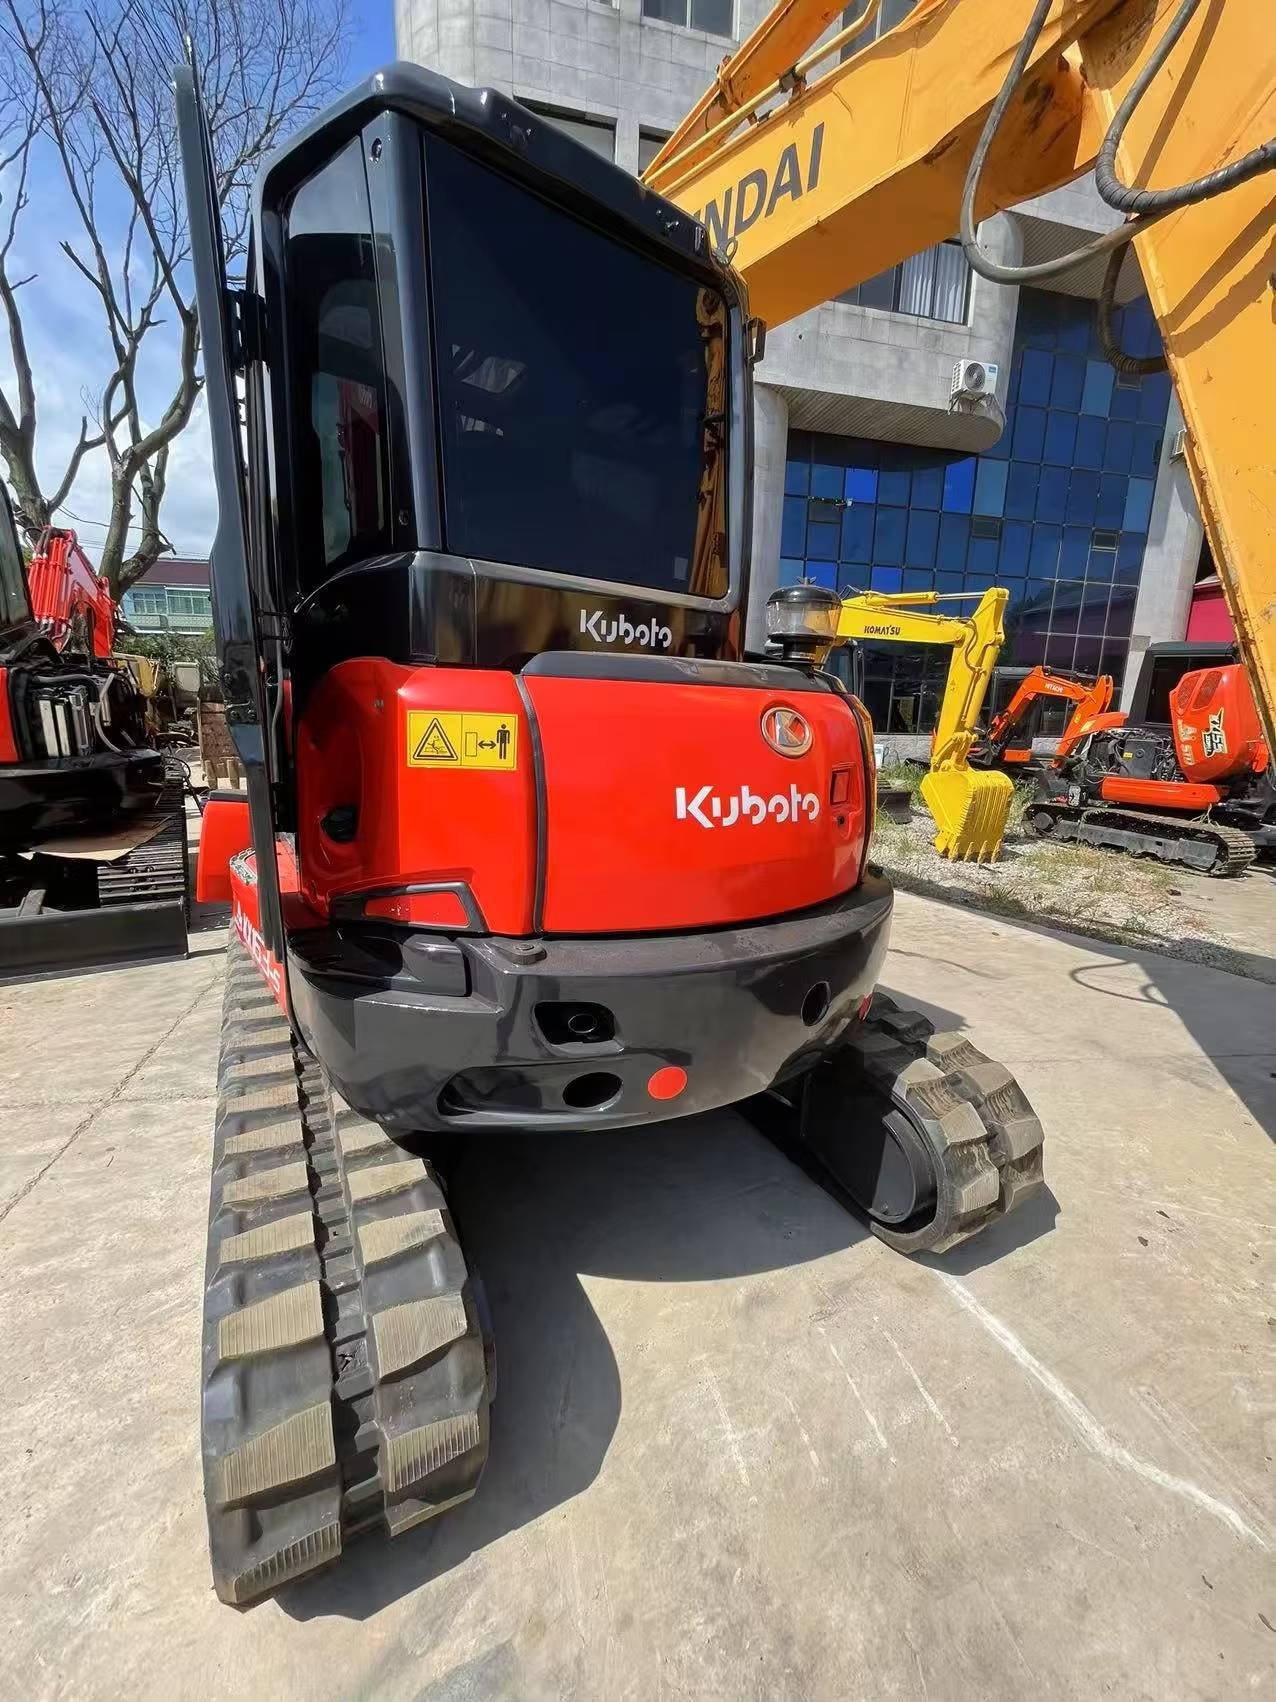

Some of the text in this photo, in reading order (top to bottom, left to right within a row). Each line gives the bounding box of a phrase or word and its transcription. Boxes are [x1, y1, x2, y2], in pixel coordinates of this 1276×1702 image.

[692, 120, 825, 251] NDAI
[580, 609, 672, 648] Kubota
[864, 625, 901, 635] KOMATSU
[675, 784, 820, 829] Kubota
